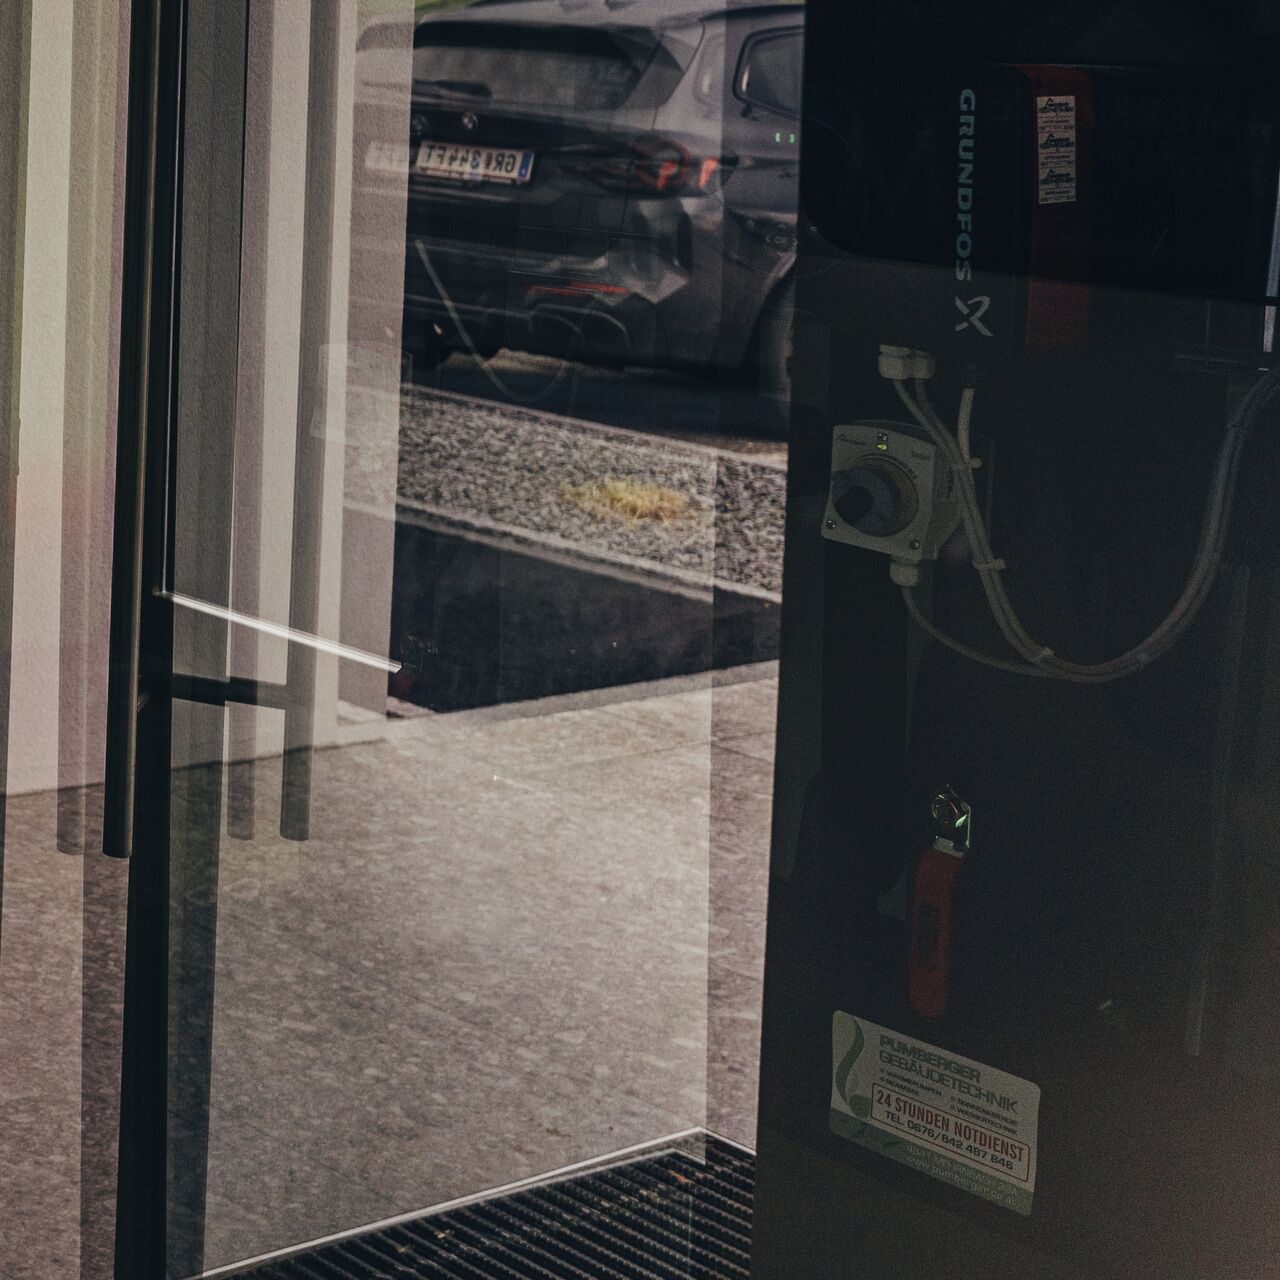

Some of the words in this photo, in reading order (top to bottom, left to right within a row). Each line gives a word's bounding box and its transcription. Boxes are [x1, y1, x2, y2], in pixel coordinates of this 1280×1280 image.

[954, 88, 977, 282] GRUNDFOS
[879, 1050, 1019, 1115] GEBÄUDETECHNIK
[876, 1089, 891, 1108] 24
[894, 1098, 950, 1132] STUNDEN
[954, 1121, 1024, 1163] NOTDIENST
[965, 1141, 987, 1159] 487
[991, 1154, 1013, 1170] 846
